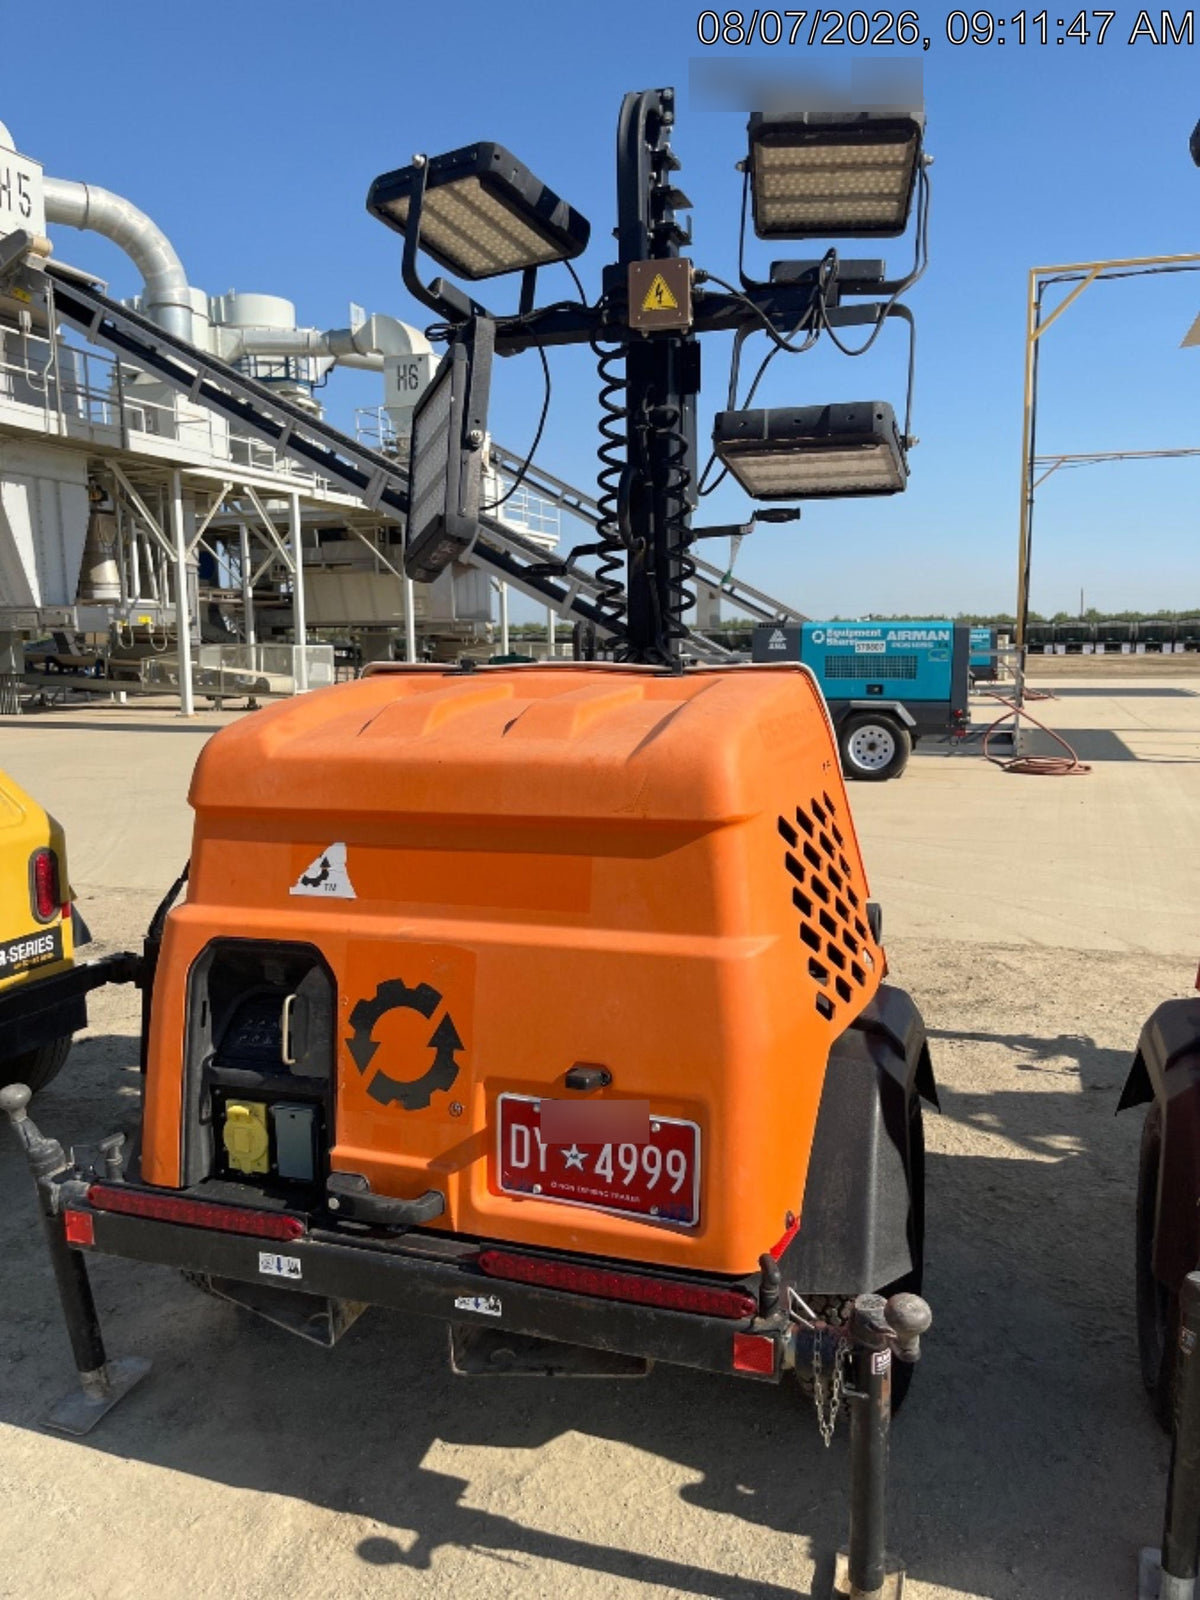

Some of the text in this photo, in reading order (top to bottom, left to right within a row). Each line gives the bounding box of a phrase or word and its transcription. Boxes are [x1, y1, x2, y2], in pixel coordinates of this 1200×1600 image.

[0, 167, 31, 218] H5
[397, 364, 419, 392] H6
[826, 629, 882, 639] Equipment
[886, 630, 950, 640] AIRMAN
[511, 1123, 687, 1194] DY 4999
